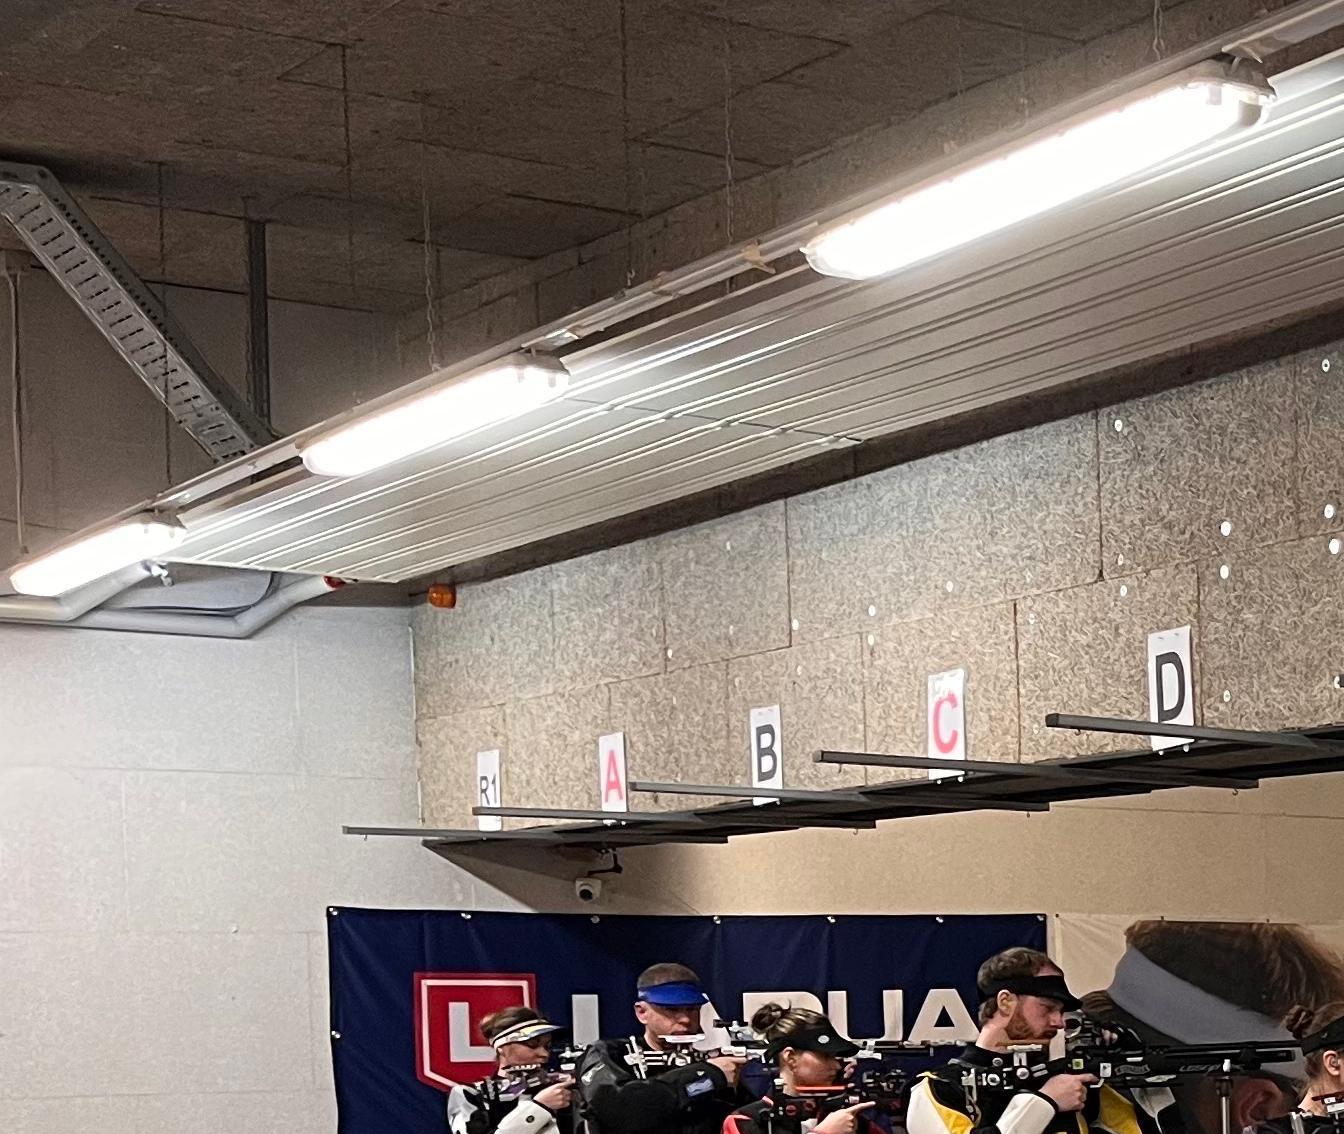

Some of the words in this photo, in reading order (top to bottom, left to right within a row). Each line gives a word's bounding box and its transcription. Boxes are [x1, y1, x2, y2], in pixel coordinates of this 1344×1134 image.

[1156, 651, 1186, 722] D
[933, 690, 958, 754] C
[604, 749, 624, 803] A
[755, 723, 778, 782] B
[479, 773, 498, 807] R1
